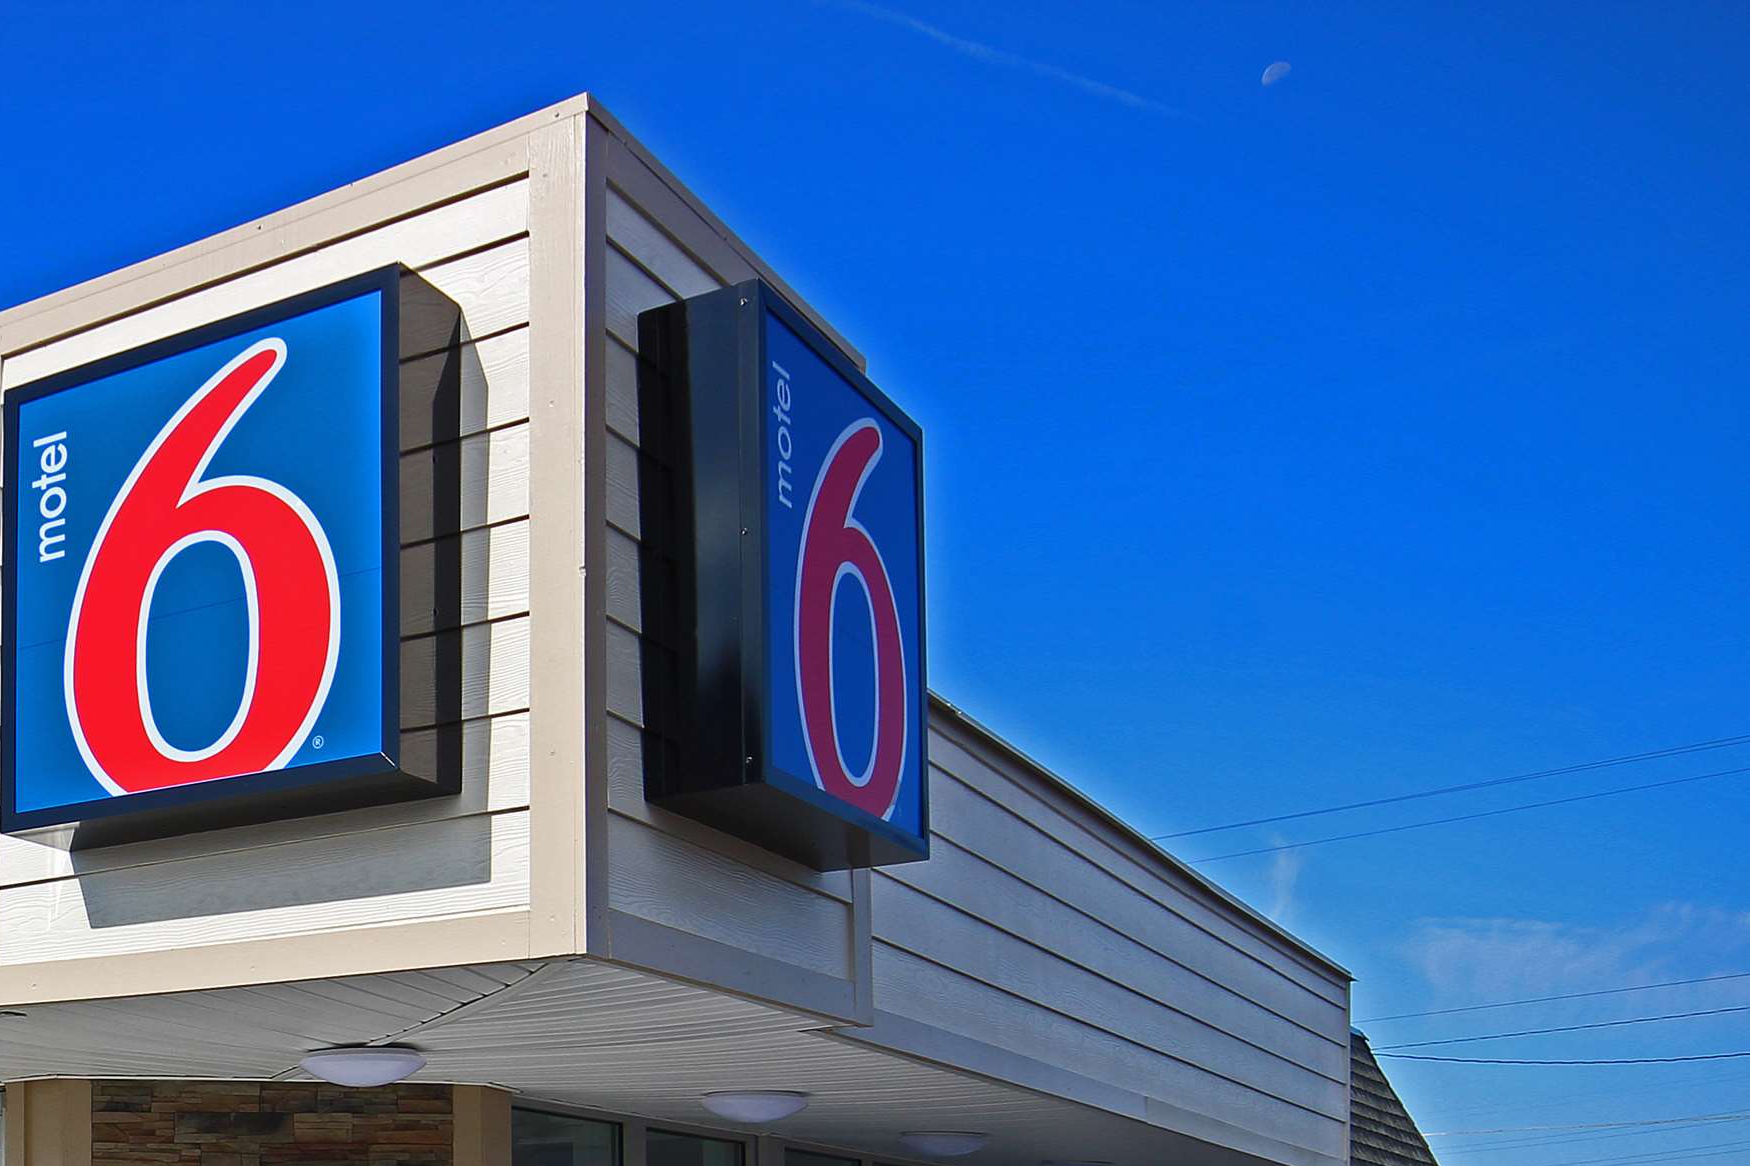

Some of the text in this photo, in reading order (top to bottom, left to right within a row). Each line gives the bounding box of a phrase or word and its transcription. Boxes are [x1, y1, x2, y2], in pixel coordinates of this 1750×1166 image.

[32, 337, 341, 797] motel 6
[772, 361, 907, 821] motel 6
